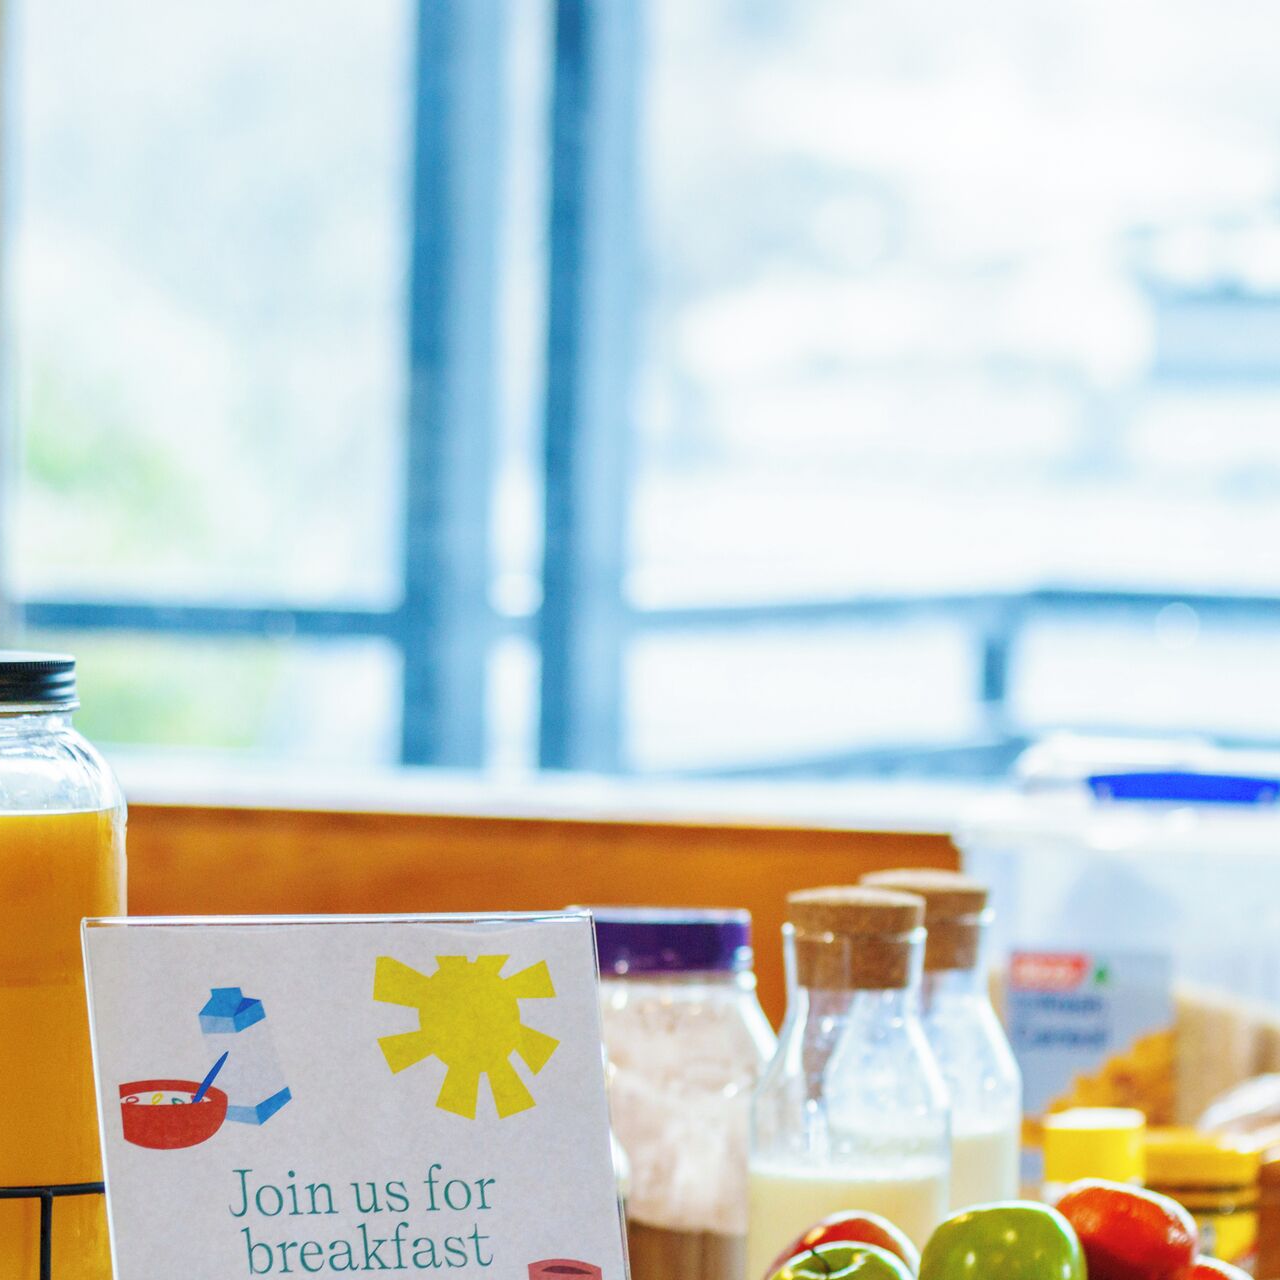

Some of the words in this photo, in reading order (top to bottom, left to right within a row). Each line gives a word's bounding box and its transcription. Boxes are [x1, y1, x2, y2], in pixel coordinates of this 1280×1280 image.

[228, 1168, 340, 1218] Join
[349, 1181, 410, 1214] us
[422, 1163, 497, 1212] for
[241, 1222, 494, 1276] breakfast
